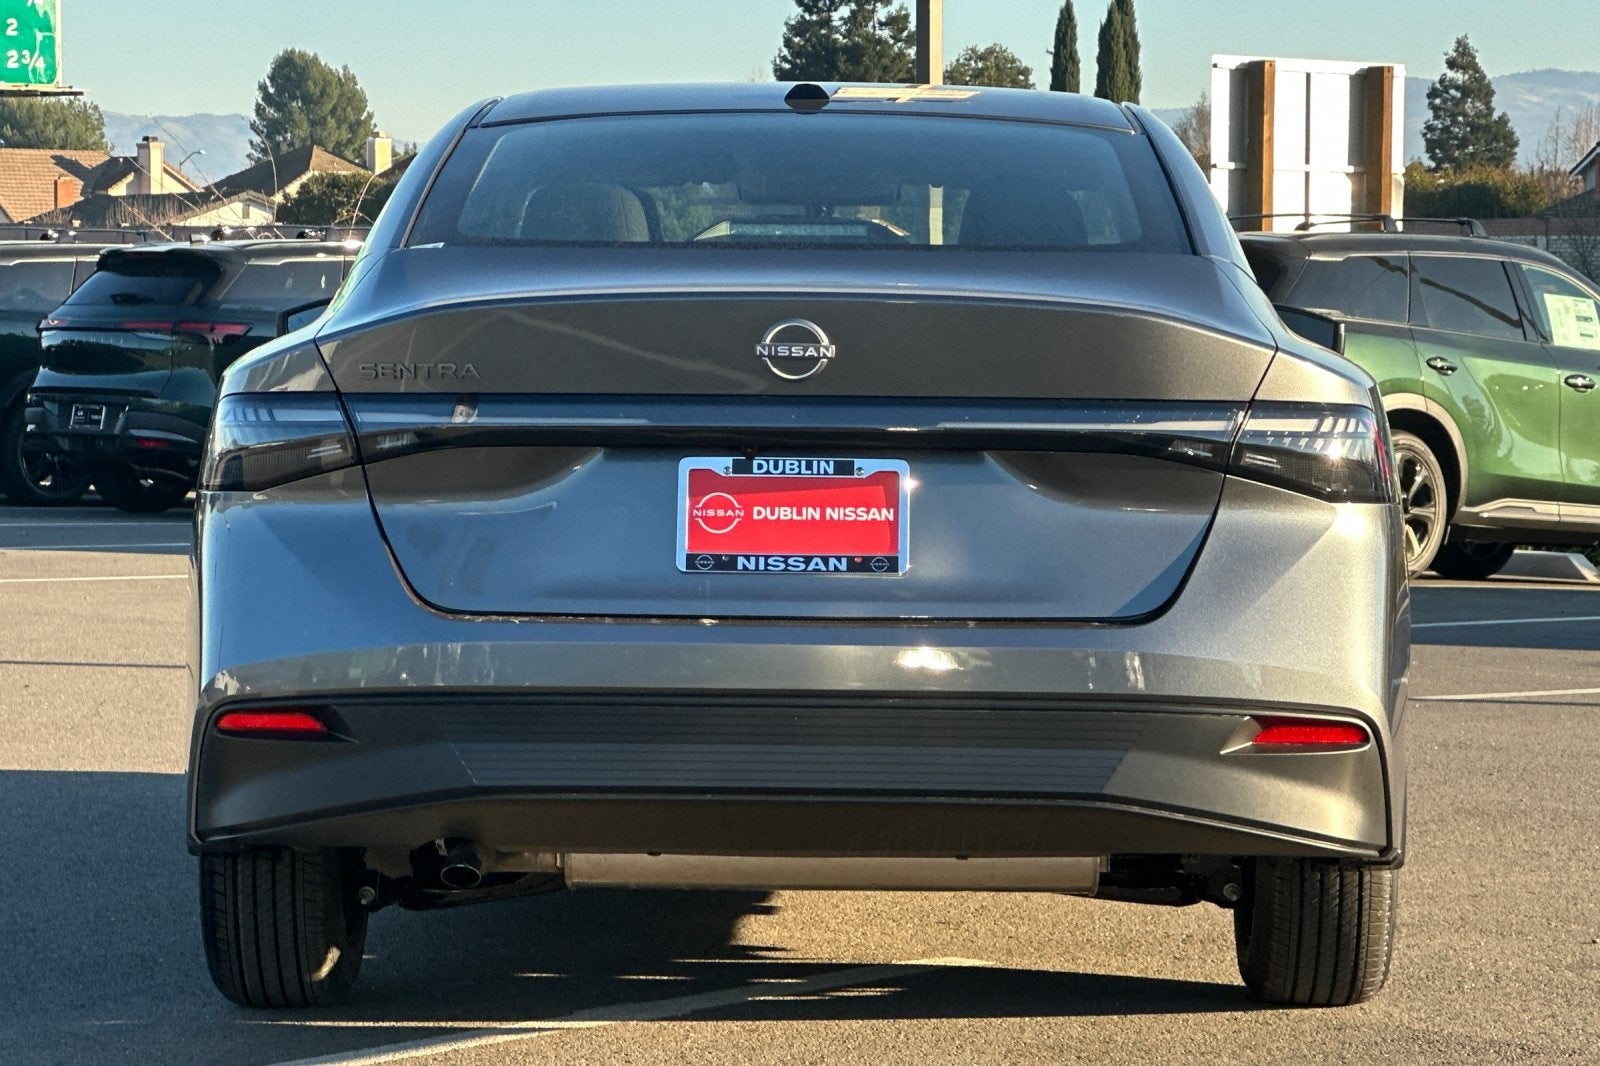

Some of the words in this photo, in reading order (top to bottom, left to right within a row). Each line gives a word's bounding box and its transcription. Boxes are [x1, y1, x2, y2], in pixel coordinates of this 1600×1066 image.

[6, 17, 19, 36] 2
[756, 345, 834, 358] NISSAN
[359, 361, 481, 380] SENTRA
[752, 459, 834, 475] DUBLIN
[692, 508, 745, 517] NISSAN
[752, 506, 820, 521] DUBLIN
[825, 507, 894, 522] NISSAN
[737, 555, 848, 572] NISSAN
